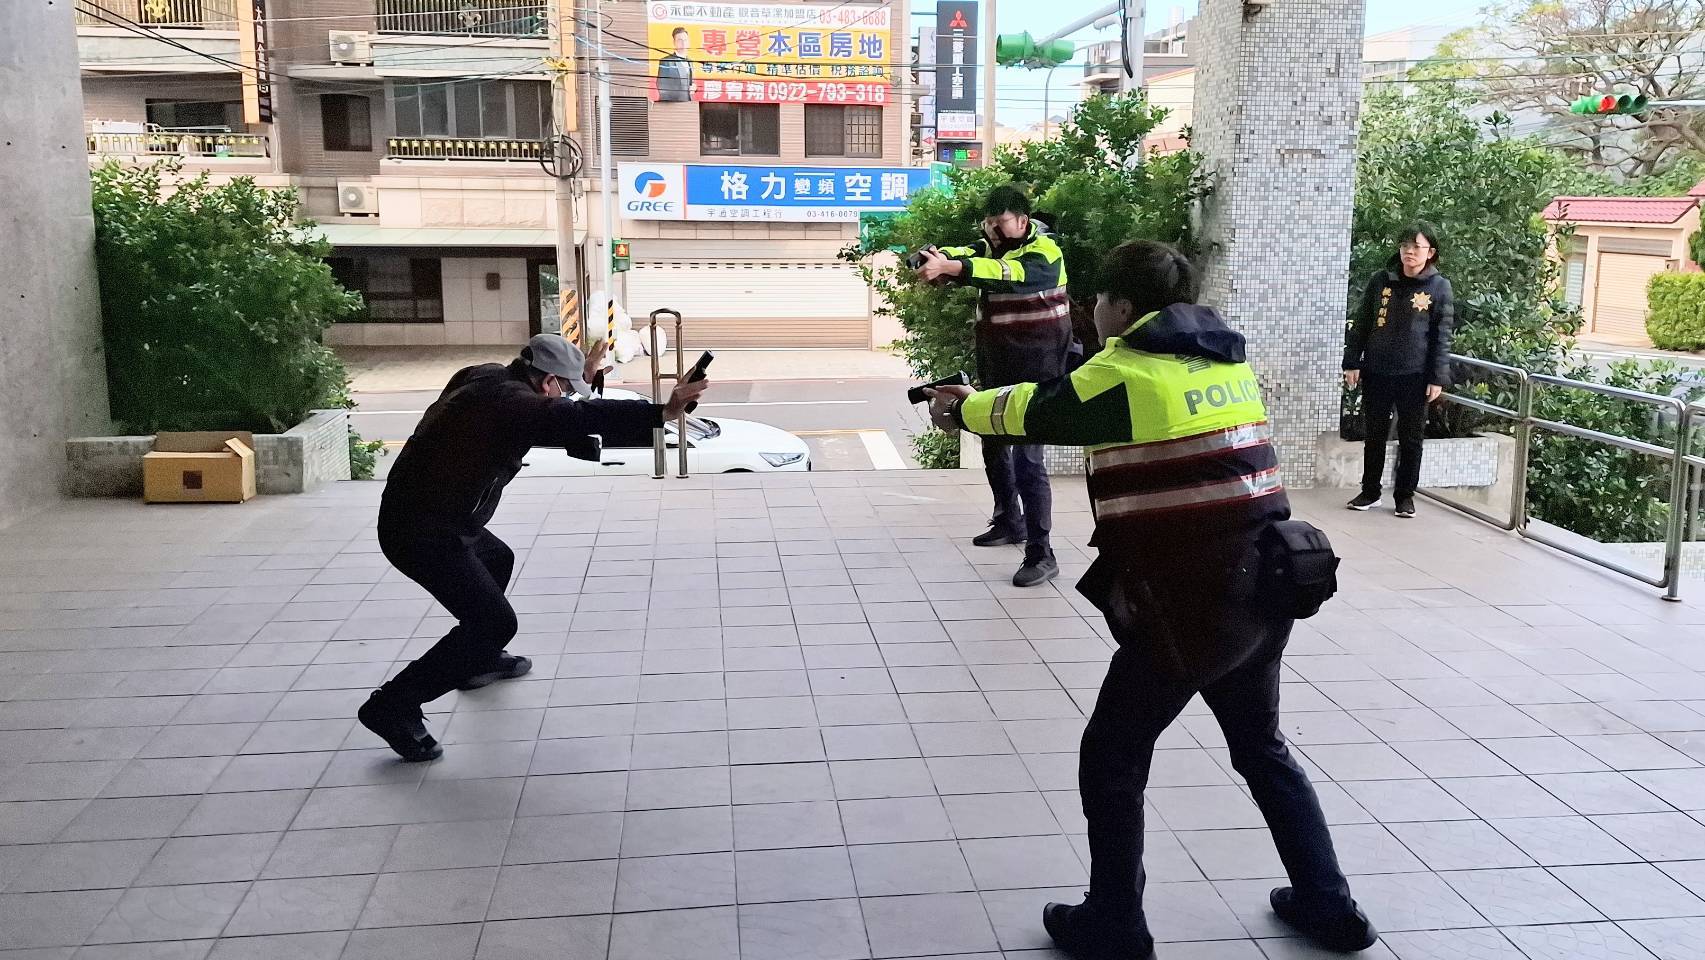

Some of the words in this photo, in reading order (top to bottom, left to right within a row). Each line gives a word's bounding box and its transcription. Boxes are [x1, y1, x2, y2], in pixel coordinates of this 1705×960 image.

[820, 9, 887, 26] 03-483-6688
[701, 29, 884, 59] 專營本區房地
[626, 200, 674, 212] GREE
